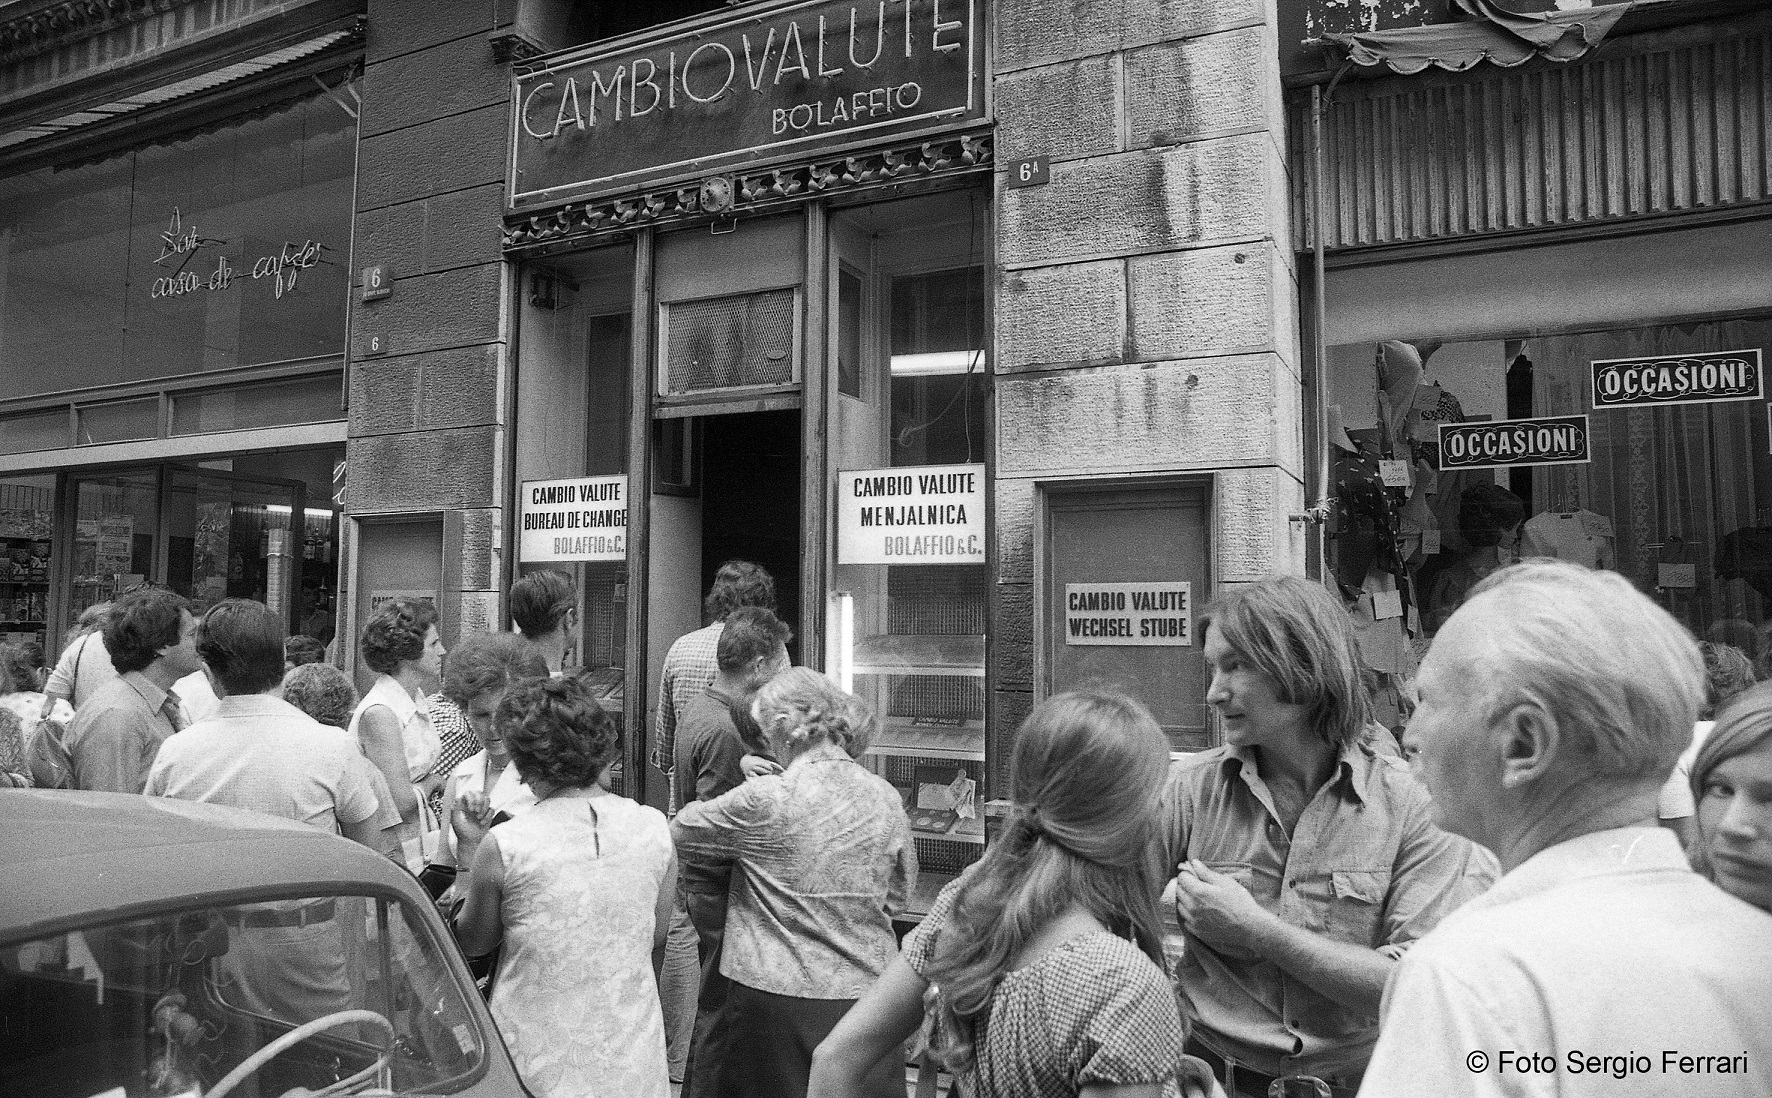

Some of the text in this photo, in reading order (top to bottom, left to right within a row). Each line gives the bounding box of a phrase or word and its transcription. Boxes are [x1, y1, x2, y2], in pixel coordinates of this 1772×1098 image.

[152, 272, 201, 299] casa
[209, 256, 234, 290] de
[371, 268, 381, 288] 6
[371, 336, 379, 351] 6
[1604, 362, 1746, 395] OCCASIONI
[1450, 428, 1576, 457] OCCASIONI
[532, 483, 620, 504] CAMBIO VALUTE
[854, 473, 975, 497] CAMBIO VALUTE
[524, 509, 627, 530] BUREAU DE CHANGE
[861, 504, 967, 526] MENJALNICA
[1069, 591, 1187, 611] CAMBIO VALUTE
[1069, 618, 1187, 637] WECHSEL STUBE
